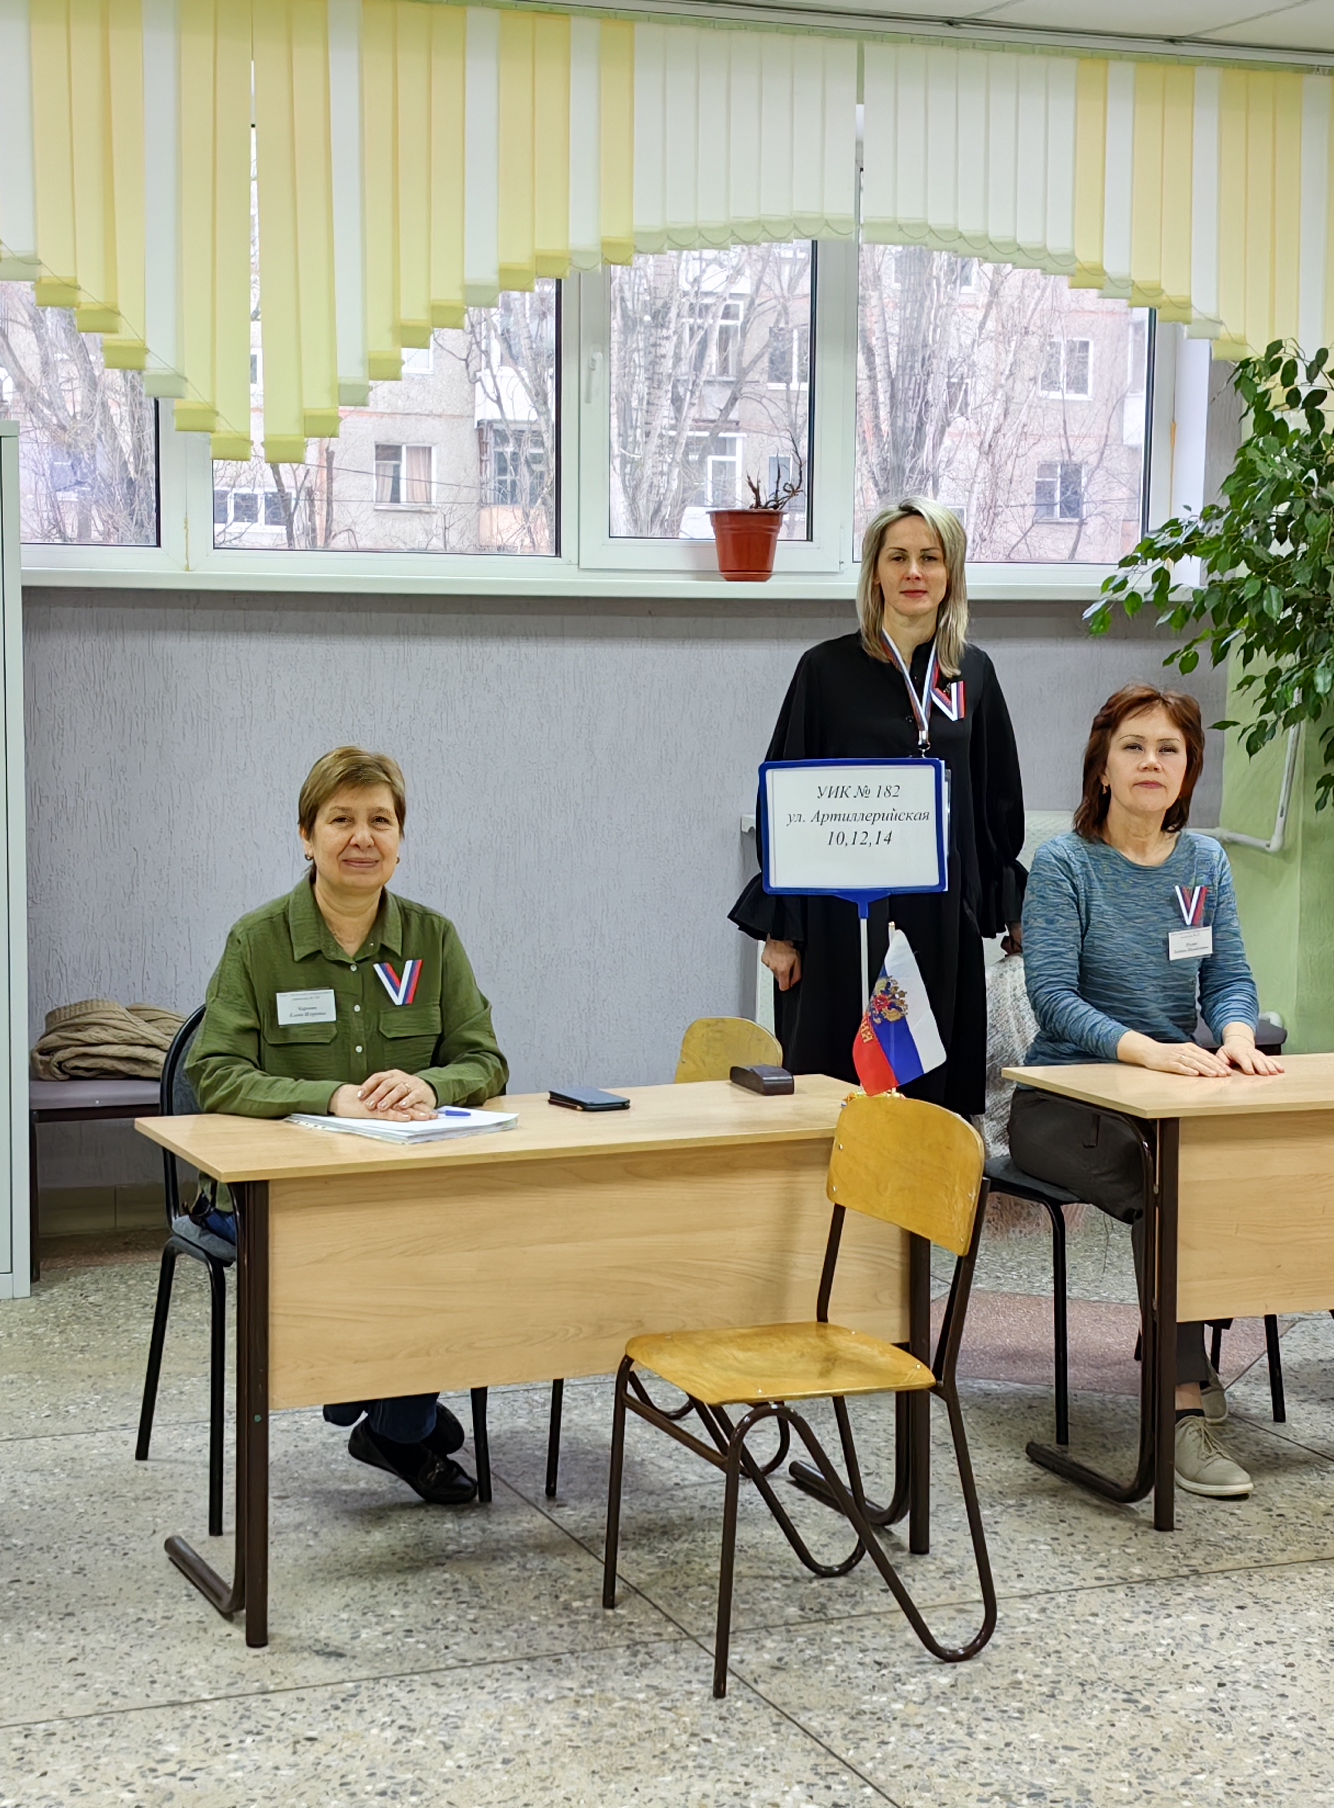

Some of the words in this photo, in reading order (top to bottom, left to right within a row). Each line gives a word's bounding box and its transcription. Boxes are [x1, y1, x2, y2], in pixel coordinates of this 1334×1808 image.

[816, 785, 852, 799] УИК
[853, 785, 871, 799] №
[875, 784, 901, 798] 182
[786, 812, 806, 827] ул.
[810, 808, 930, 826] Артиллерийская
[827, 830, 893, 847] 10,12,14
